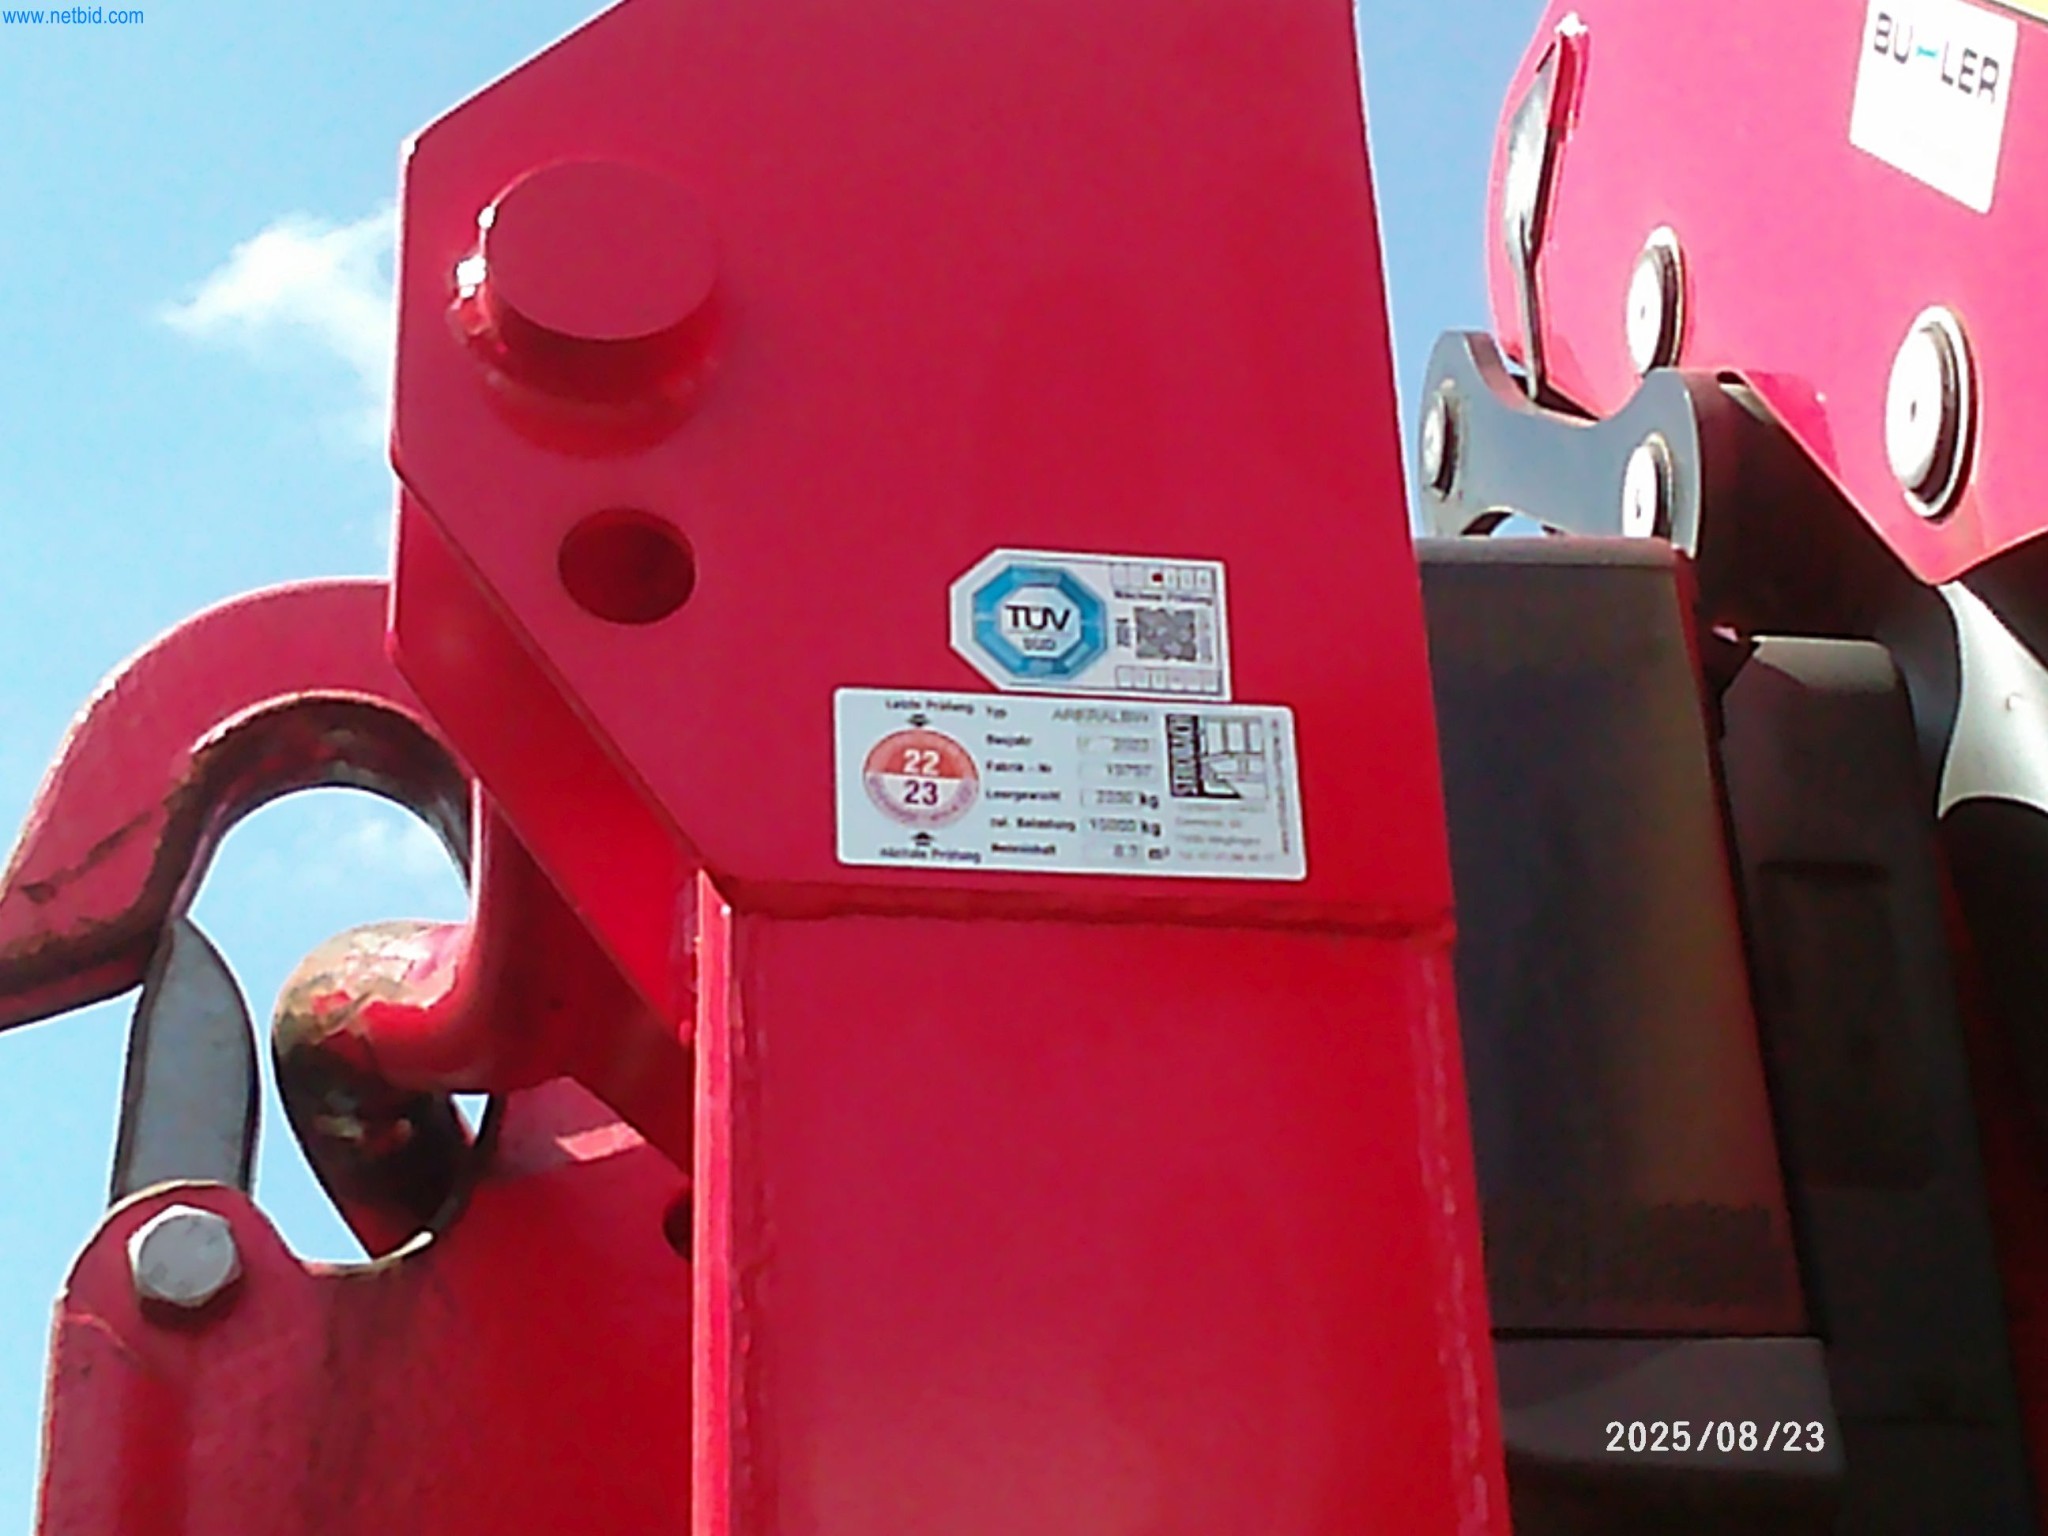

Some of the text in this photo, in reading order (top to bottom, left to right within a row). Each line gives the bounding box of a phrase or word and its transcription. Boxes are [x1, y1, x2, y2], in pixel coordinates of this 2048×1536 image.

[1005, 604, 1071, 631] TÜV
[903, 748, 941, 776] 22
[903, 779, 939, 806] 23
